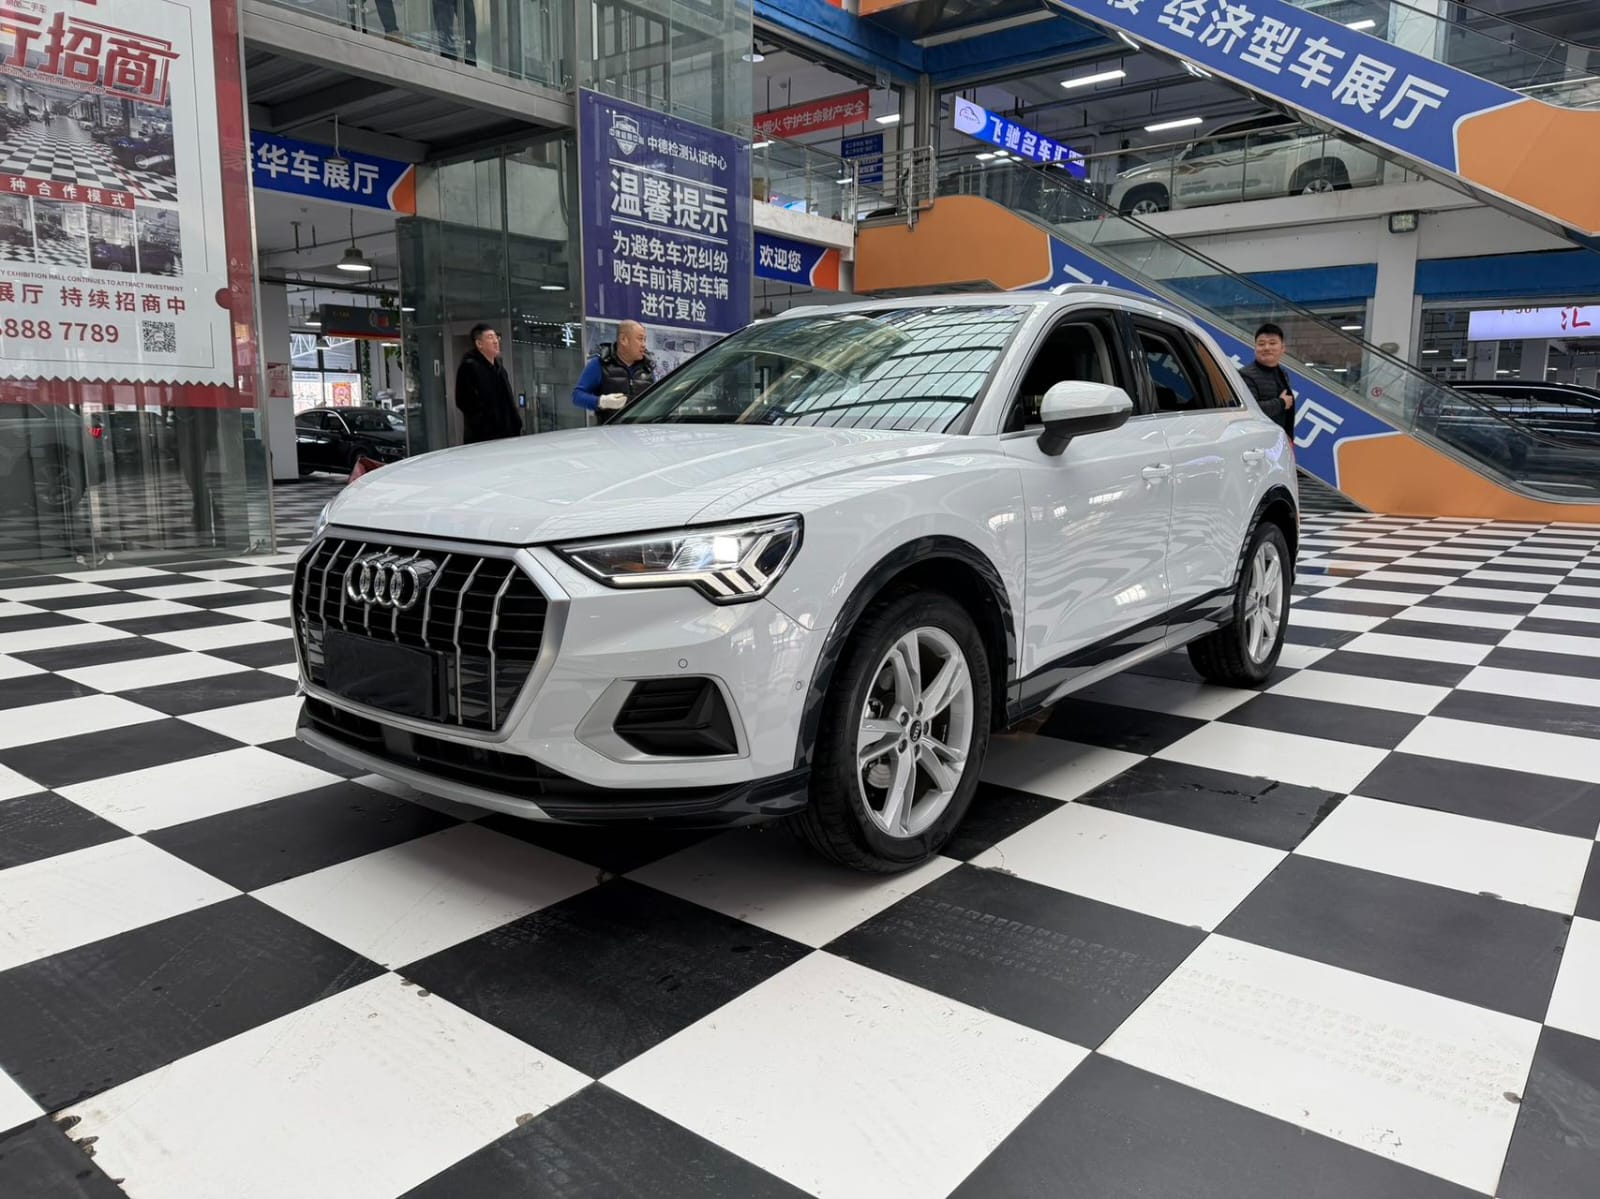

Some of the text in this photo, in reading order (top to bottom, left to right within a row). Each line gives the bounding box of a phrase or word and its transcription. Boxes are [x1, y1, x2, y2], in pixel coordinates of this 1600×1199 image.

[1158, 0, 1449, 129] 经济型车展厅
[783, 99, 865, 130] 守护生命财产安全
[647, 136, 728, 170] 中德检测认证中心
[10, 177, 126, 207] 种合作模式
[610, 169, 728, 234] 温馨提示
[613, 230, 728, 274] 为避免车况纠纷
[759, 245, 801, 272] 欢迎您
[7, 270, 47, 279] EXHIBITION
[49, 273, 66, 281] HALL
[67, 275, 106, 285] CONTINUES
[117, 280, 144, 289] ATTRACT
[145, 283, 183, 292] INVESTMENT
[613, 259, 729, 300] 购车前请对车辆
[0, 281, 186, 315] 展厅 持续招商中
[641, 291, 706, 322] 进行复检
[0, 318, 119, 343] 888 7789
